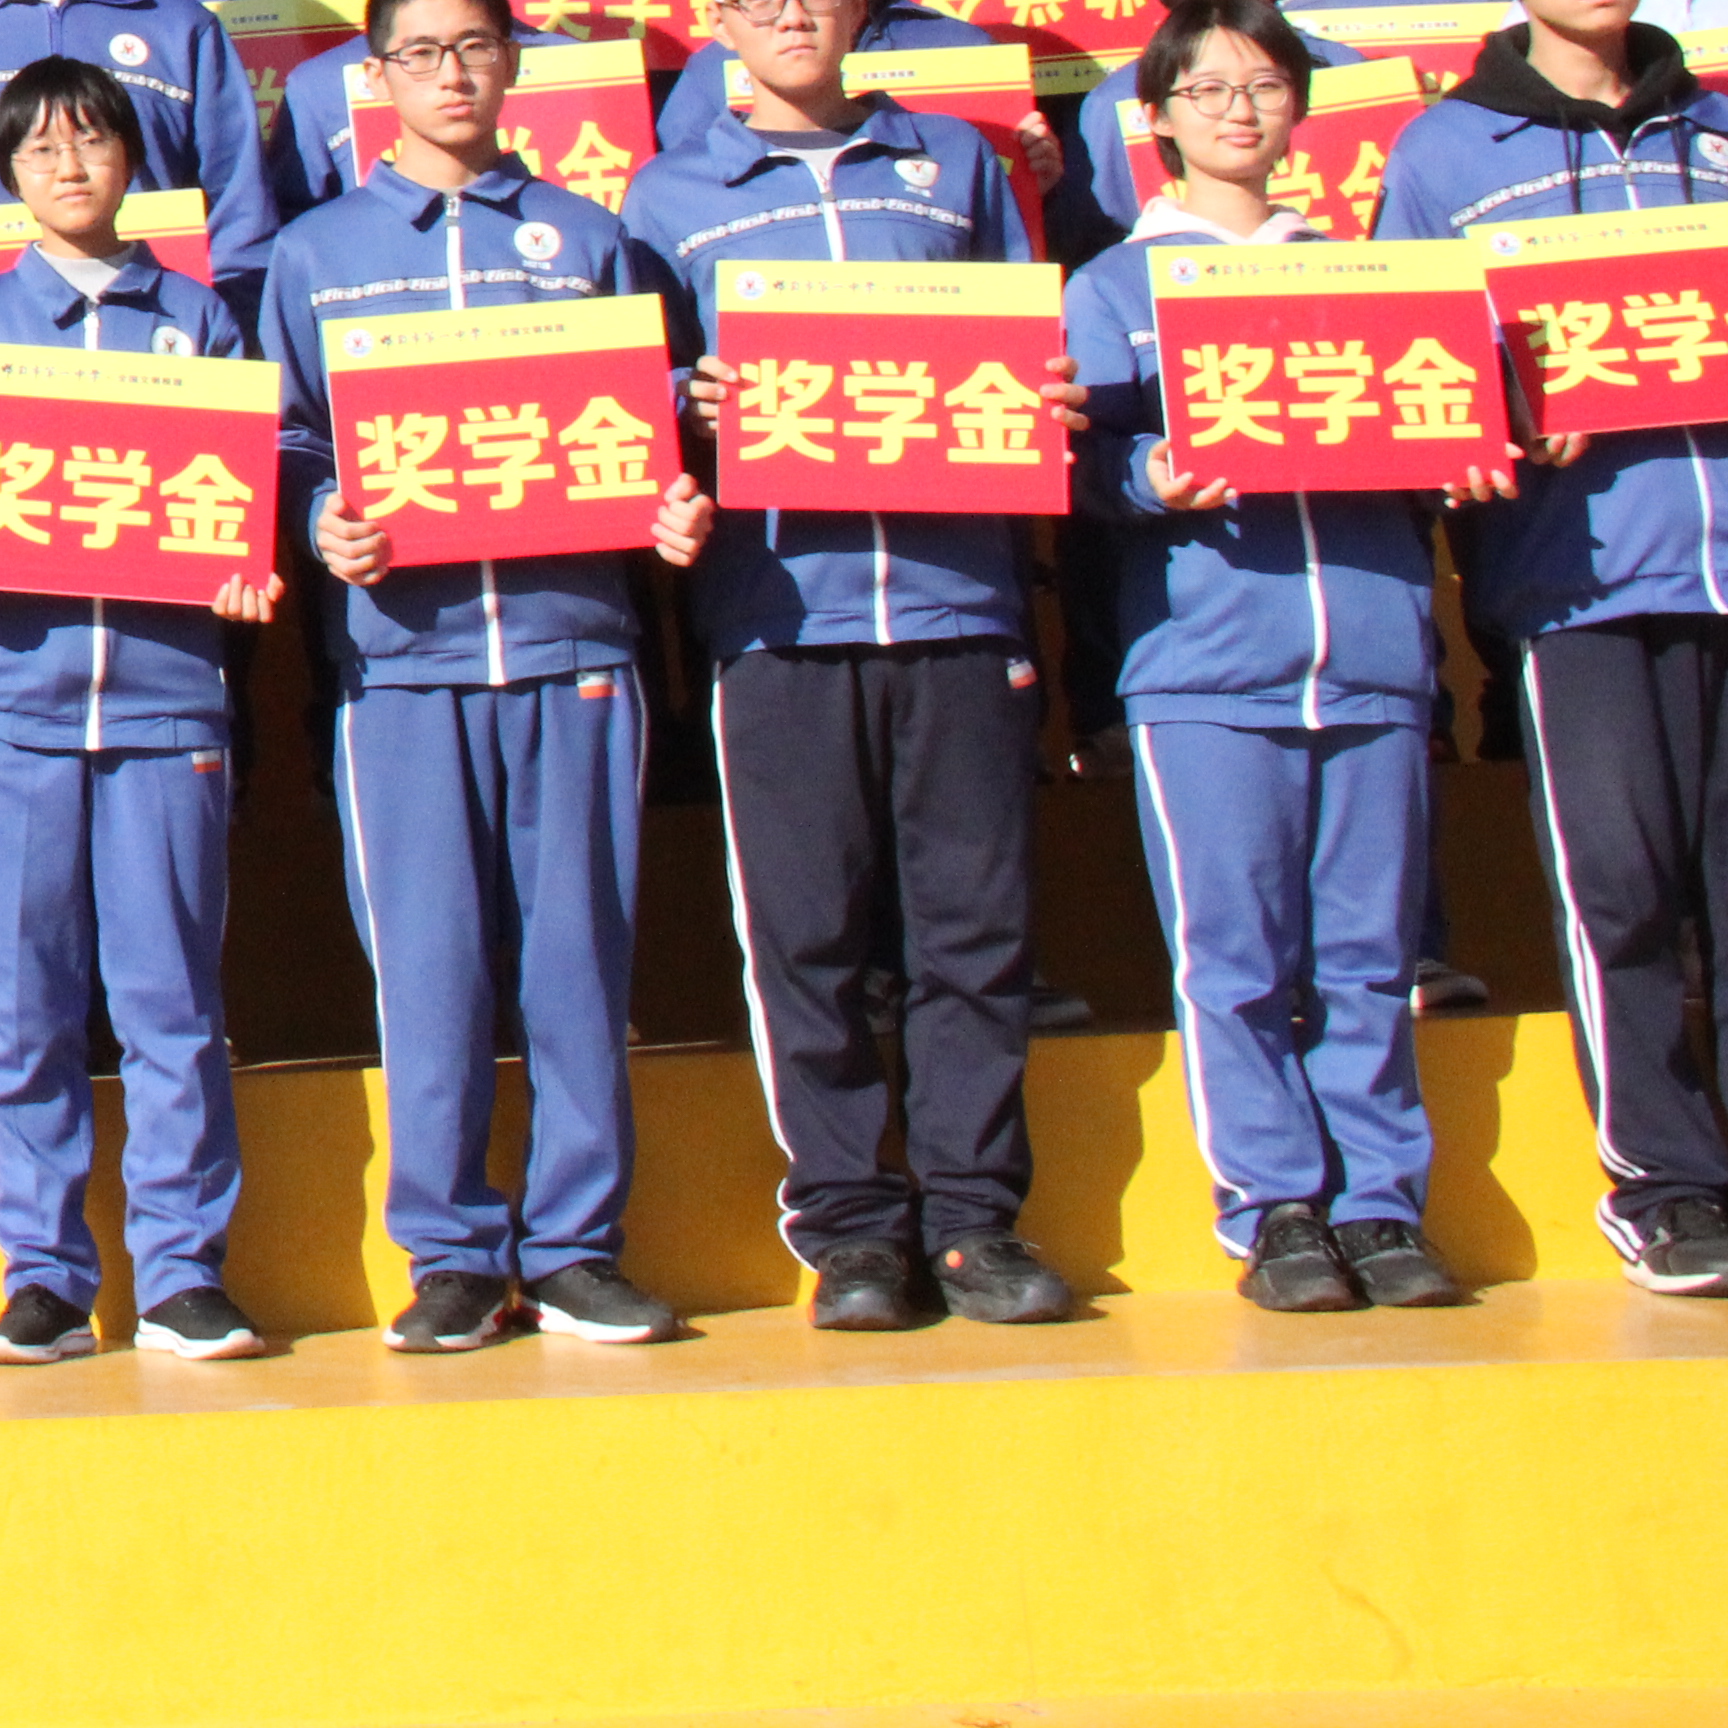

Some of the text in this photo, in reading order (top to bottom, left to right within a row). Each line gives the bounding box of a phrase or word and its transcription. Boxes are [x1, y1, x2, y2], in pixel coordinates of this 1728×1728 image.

[1182, 337, 1483, 447] 奖学金
[1518, 290, 1728, 394] 奖学
[356, 396, 659, 520] 奖学金
[739, 359, 1042, 464] 奖学金
